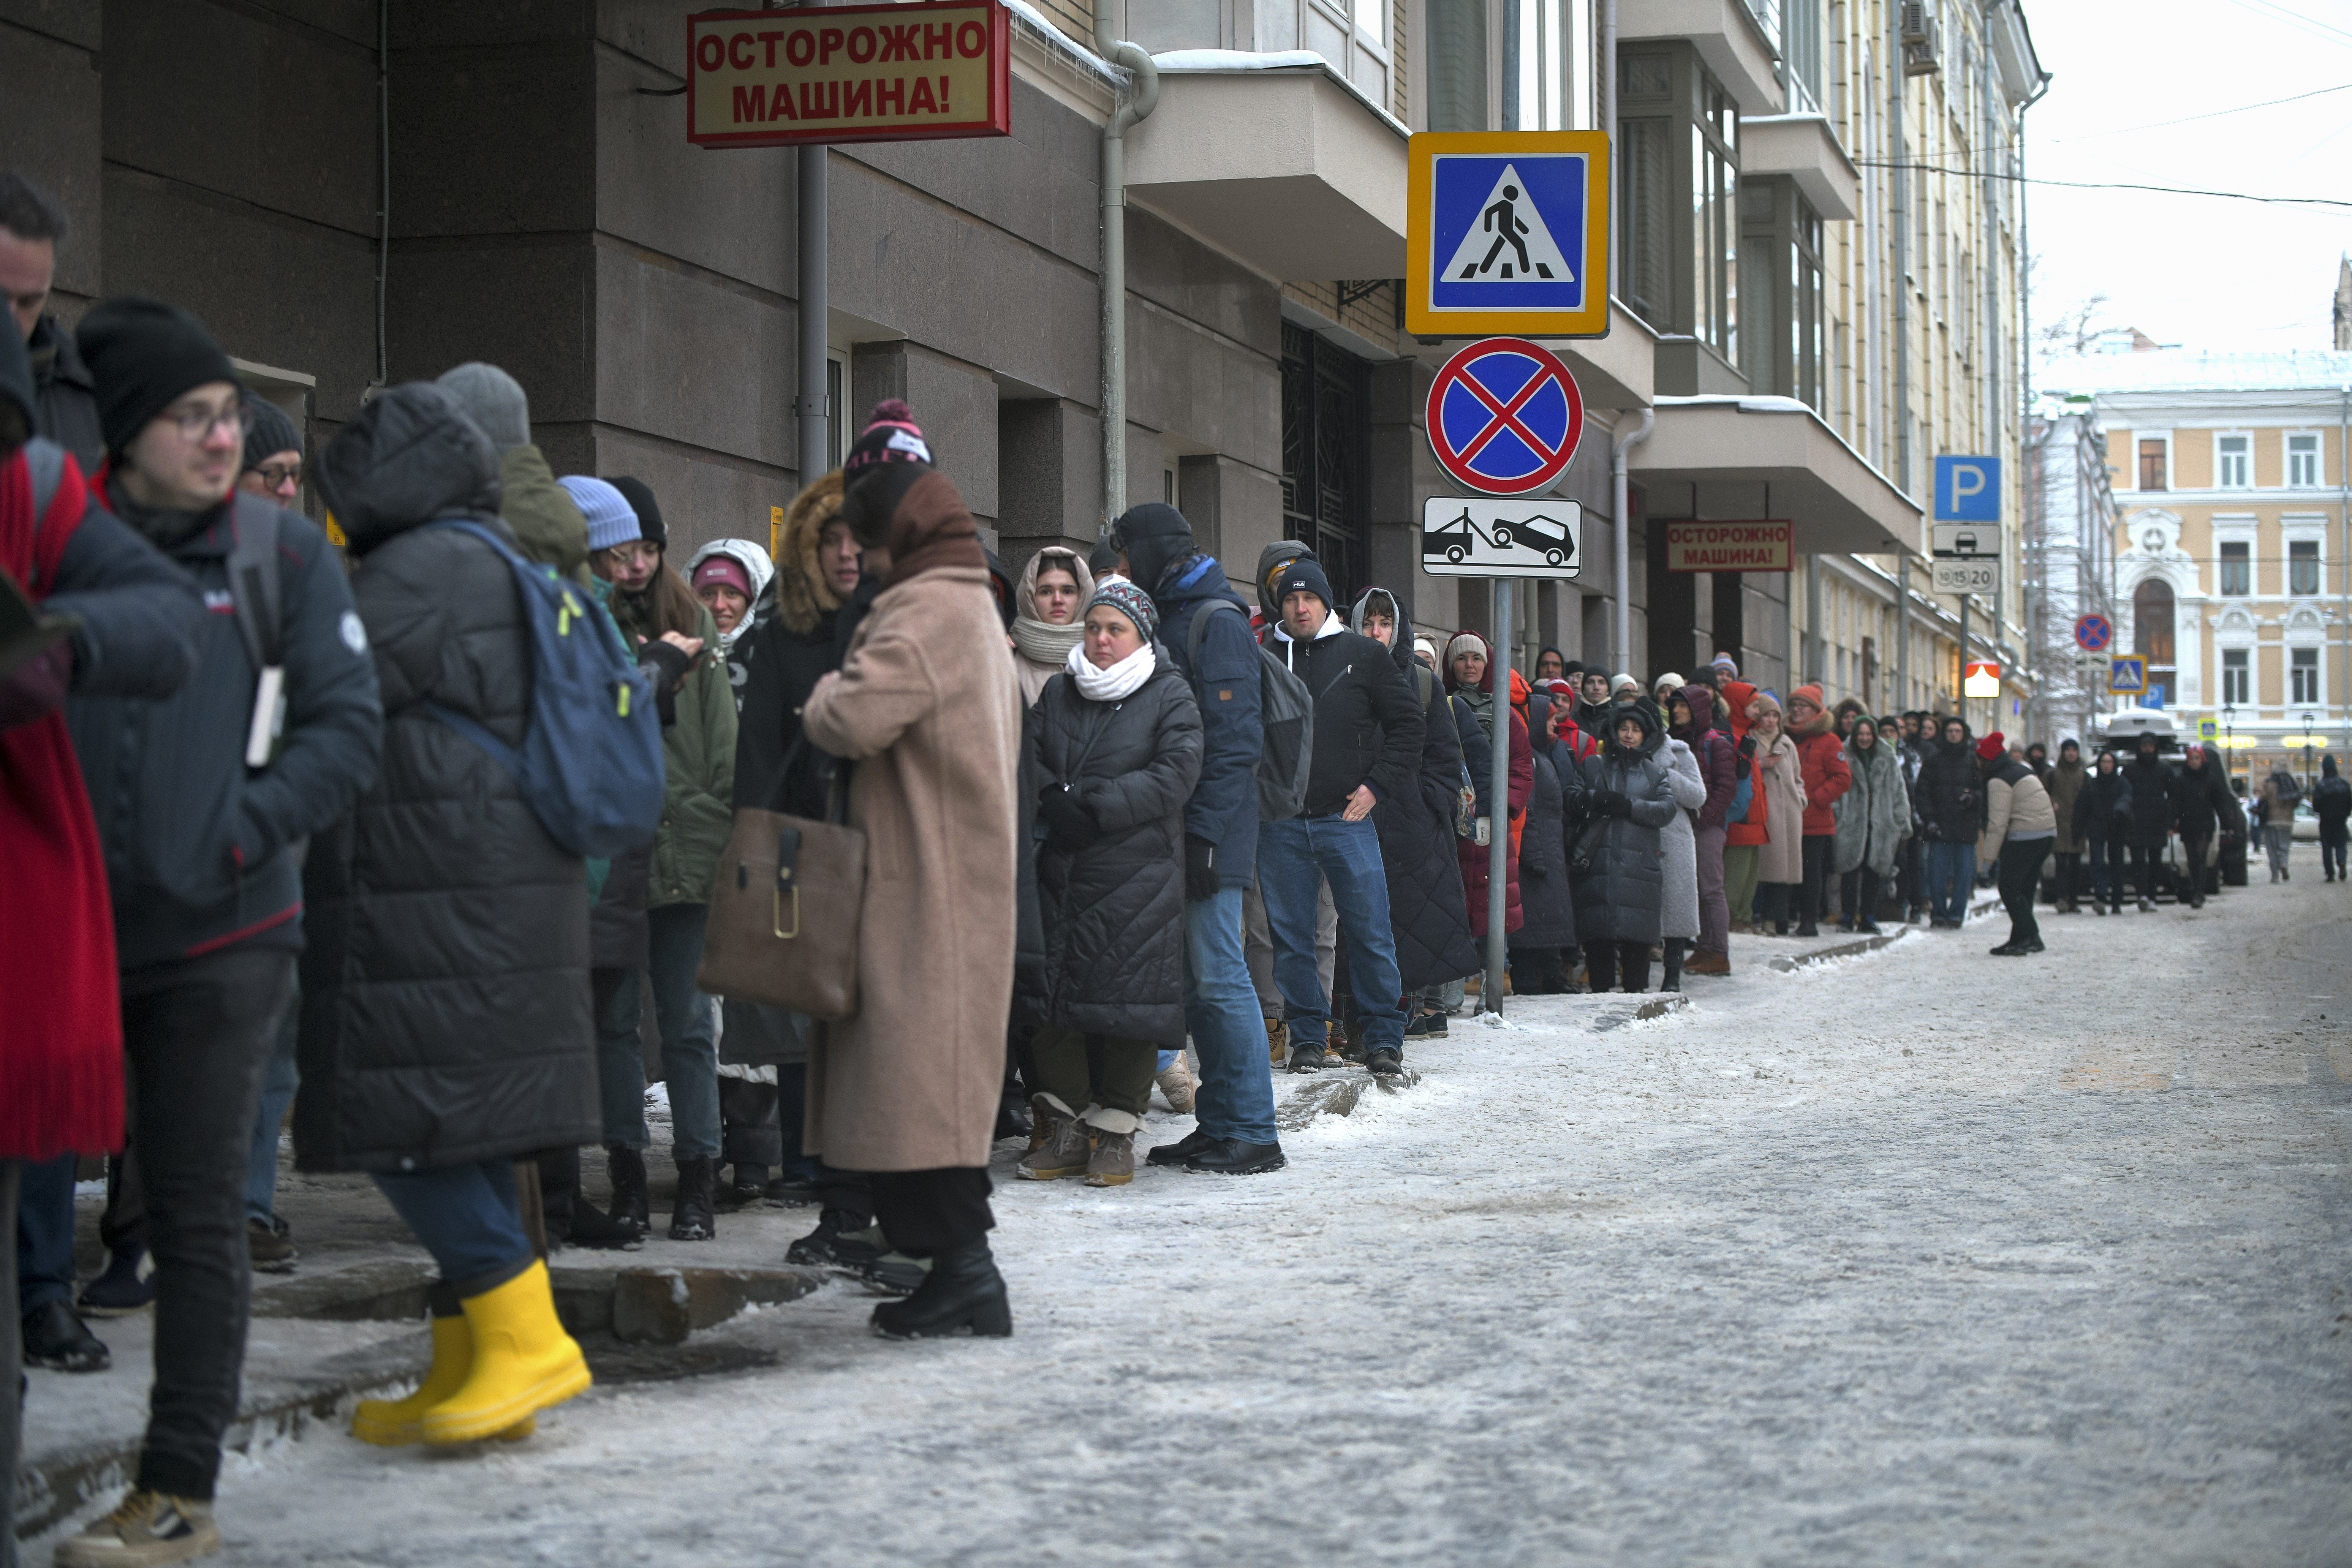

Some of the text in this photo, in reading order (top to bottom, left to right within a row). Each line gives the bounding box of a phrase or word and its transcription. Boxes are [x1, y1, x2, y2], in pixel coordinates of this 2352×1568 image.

[696, 21, 987, 72] ОСТОРОЖНО
[733, 76, 949, 123] МАШИНА!
[1669, 527, 1786, 544] ОСТОРОЖНО
[1684, 549, 1773, 564] МАШИНА!
[1972, 570, 1990, 584] 20
